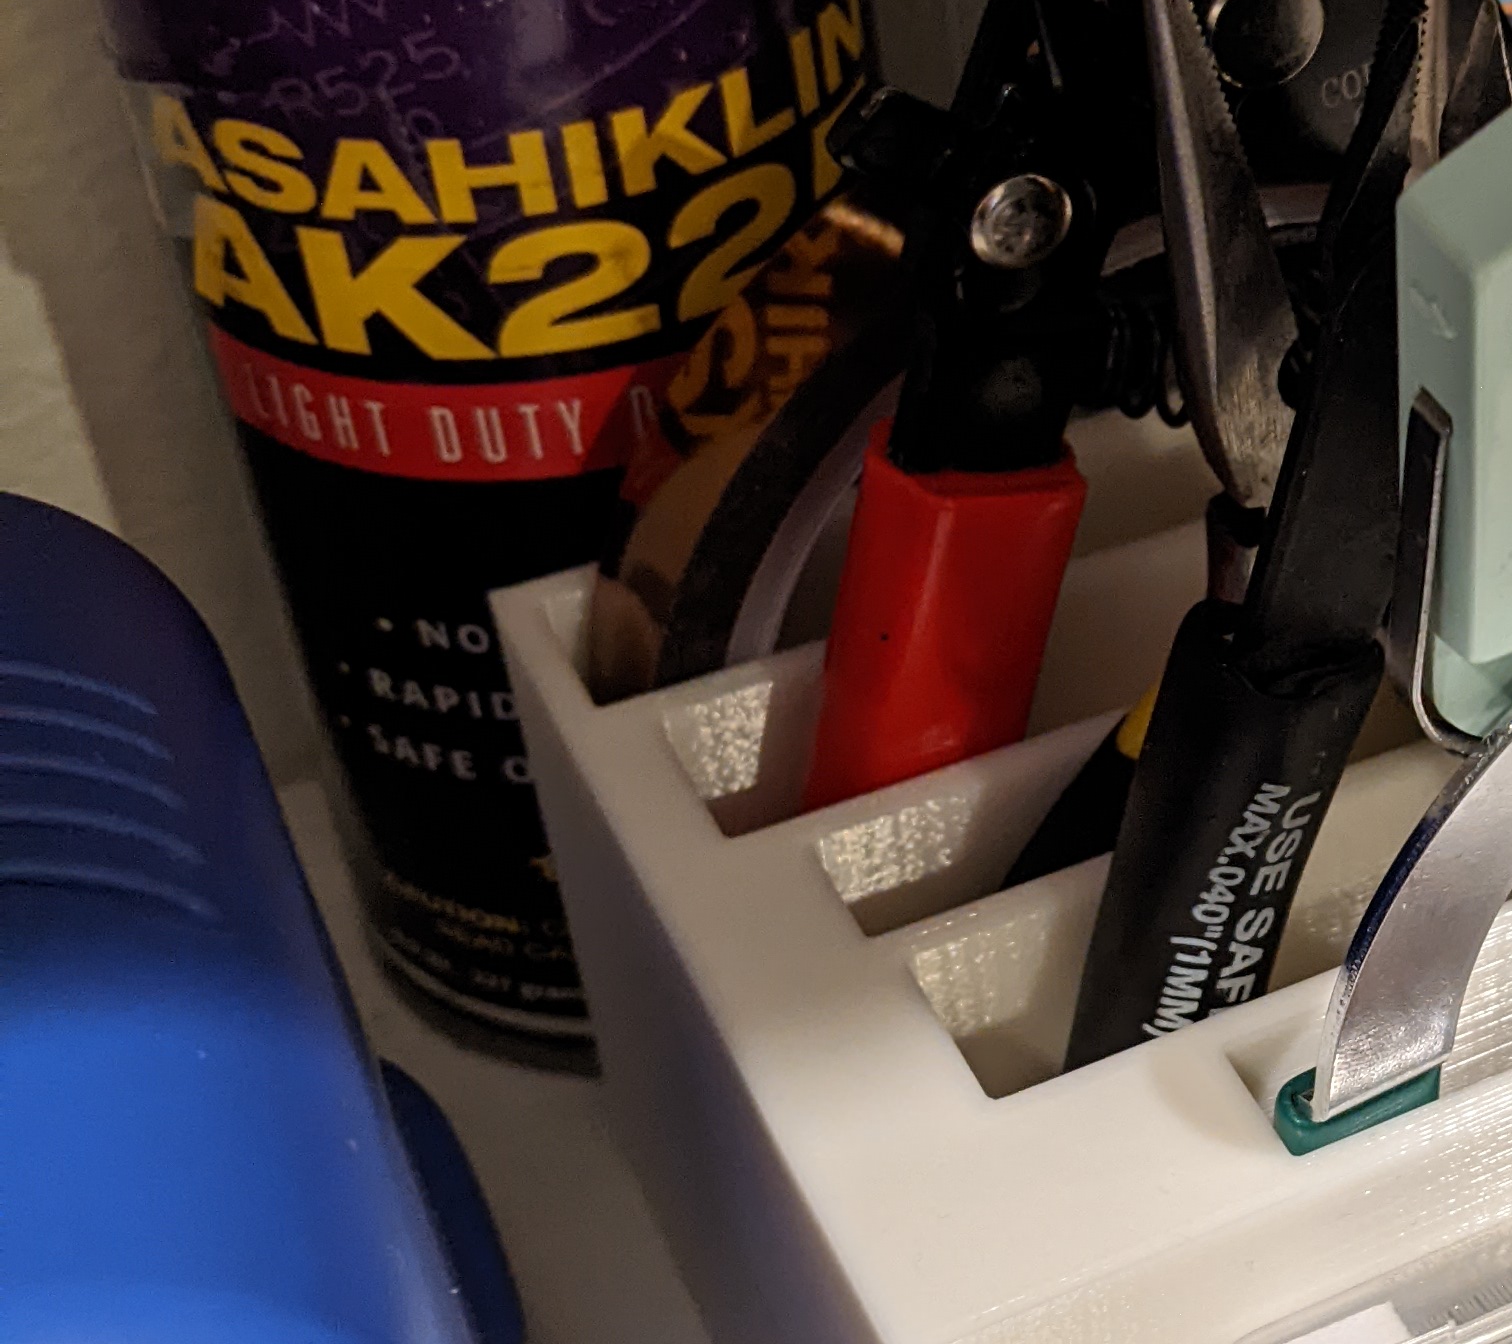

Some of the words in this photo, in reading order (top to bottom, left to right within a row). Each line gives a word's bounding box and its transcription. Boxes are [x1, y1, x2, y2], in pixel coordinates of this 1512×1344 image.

[243, 362, 392, 457] LIGHT
[425, 398, 585, 465] DUTY
[1249, 791, 1322, 896] USE
[1210, 906, 1276, 1016] SAF
